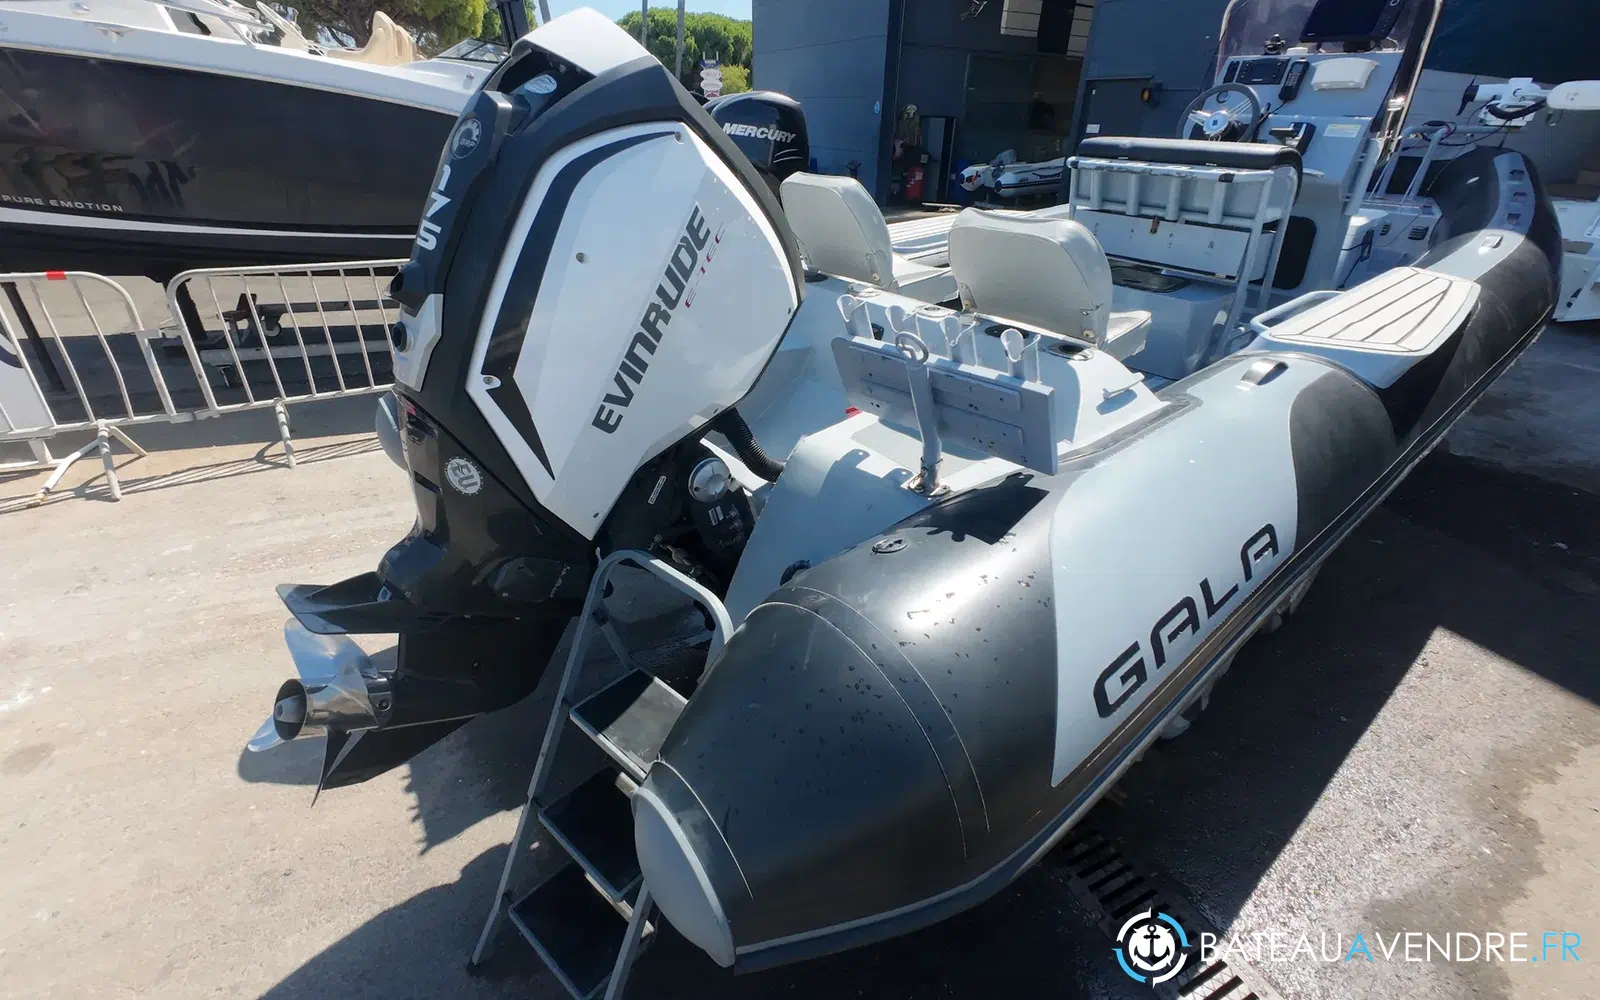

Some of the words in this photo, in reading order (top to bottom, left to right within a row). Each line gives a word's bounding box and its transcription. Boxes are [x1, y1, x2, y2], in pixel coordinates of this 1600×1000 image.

[722, 122, 797, 144] MERCURY
[1, 194, 45, 206] PURE
[49, 199, 124, 212] EMOTION
[416, 164, 452, 251] 175
[591, 204, 711, 434] EVINRUDE
[1093, 523, 1279, 719] GALA
